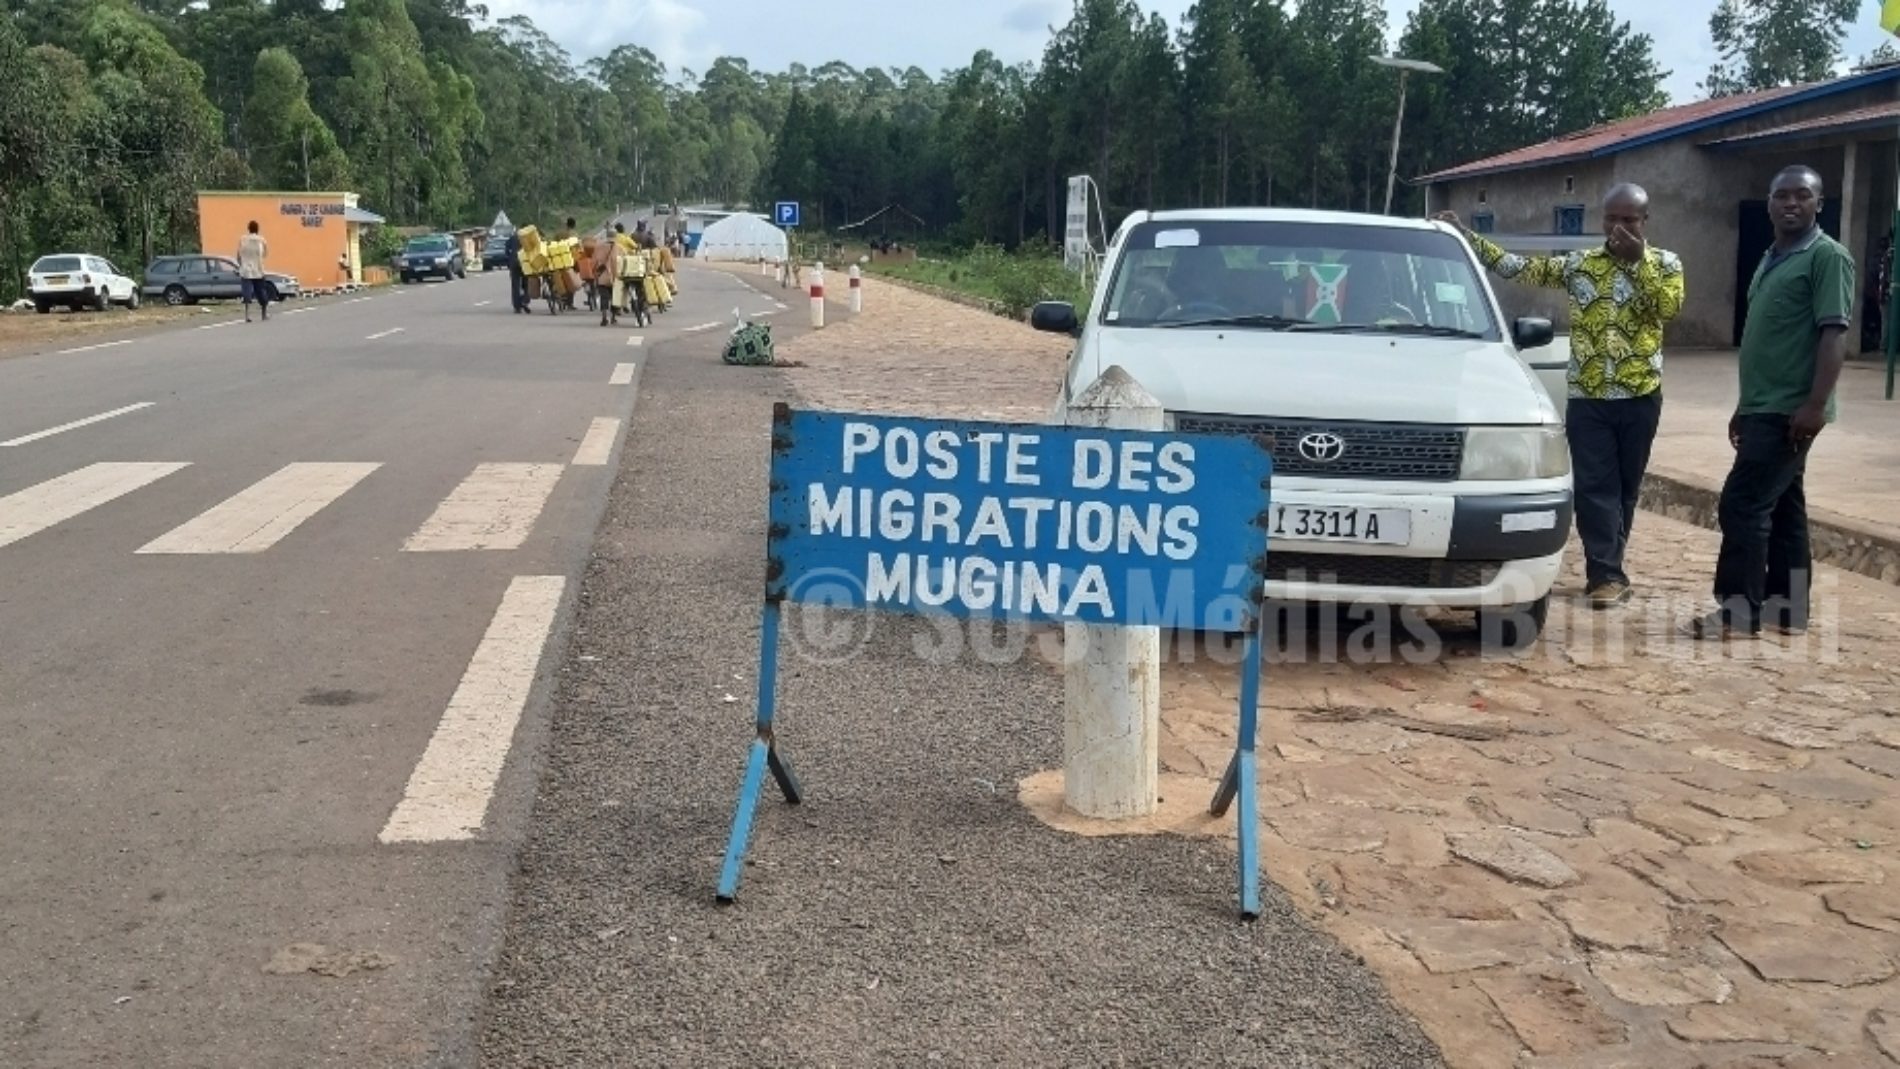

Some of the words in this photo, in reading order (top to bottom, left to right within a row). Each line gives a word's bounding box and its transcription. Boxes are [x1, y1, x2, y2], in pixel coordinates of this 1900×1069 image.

[781, 206, 793, 221] P
[842, 422, 1040, 486] POSTE
[1072, 438, 1196, 494] DES
[808, 483, 1199, 560] MIGRATIONS
[1295, 507, 1358, 538] 3311
[1365, 513, 1379, 539] A
[866, 552, 1114, 618] MUGINA
